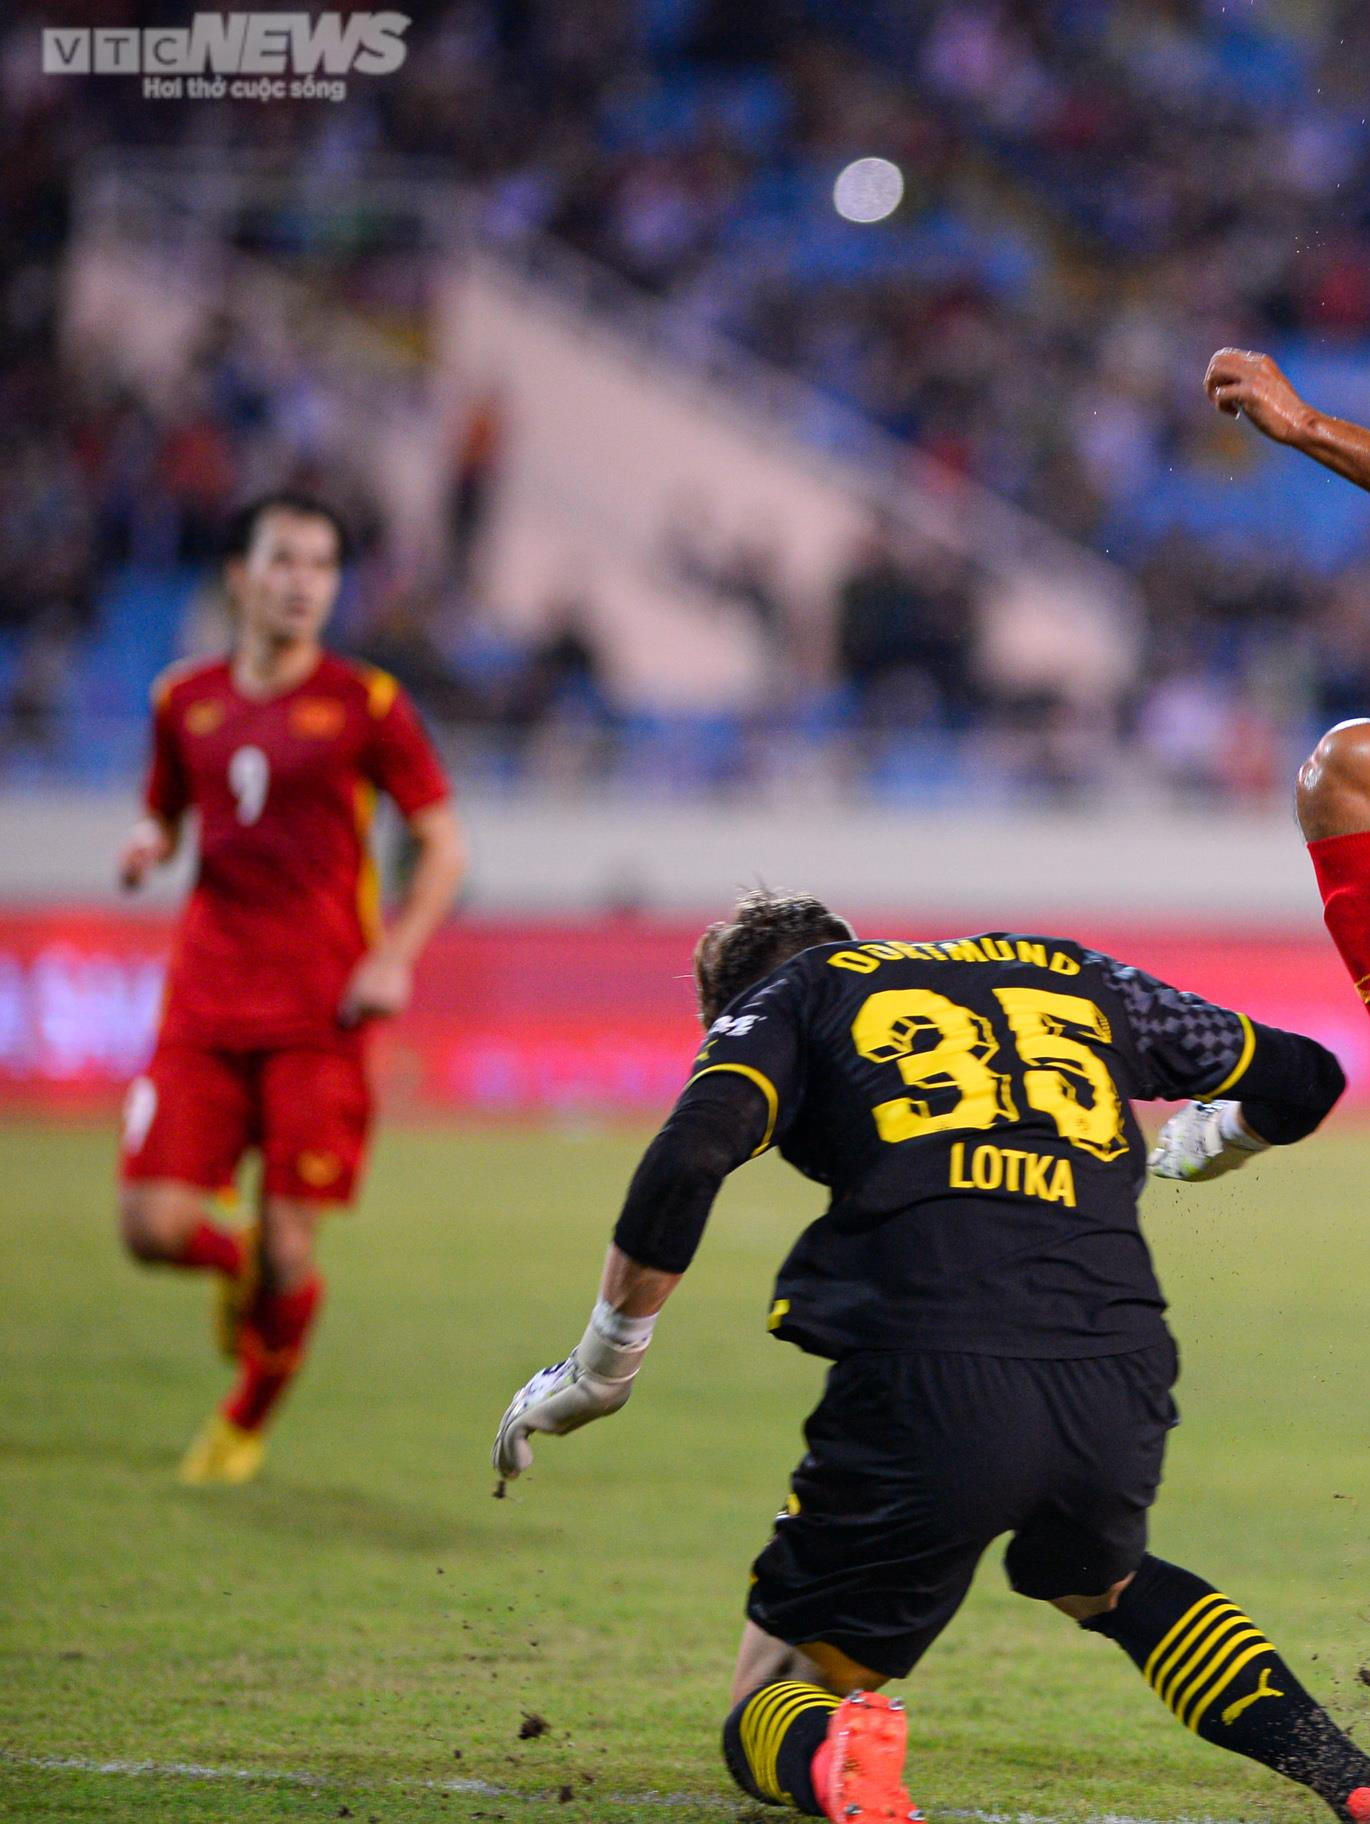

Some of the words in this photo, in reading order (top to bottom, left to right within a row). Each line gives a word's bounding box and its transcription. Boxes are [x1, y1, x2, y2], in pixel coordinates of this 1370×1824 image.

[228, 745, 269, 827] 9
[827, 938, 1081, 976] DORTMUND
[851, 986, 1129, 1162] 35
[949, 1142, 1077, 1208] LOTKA
